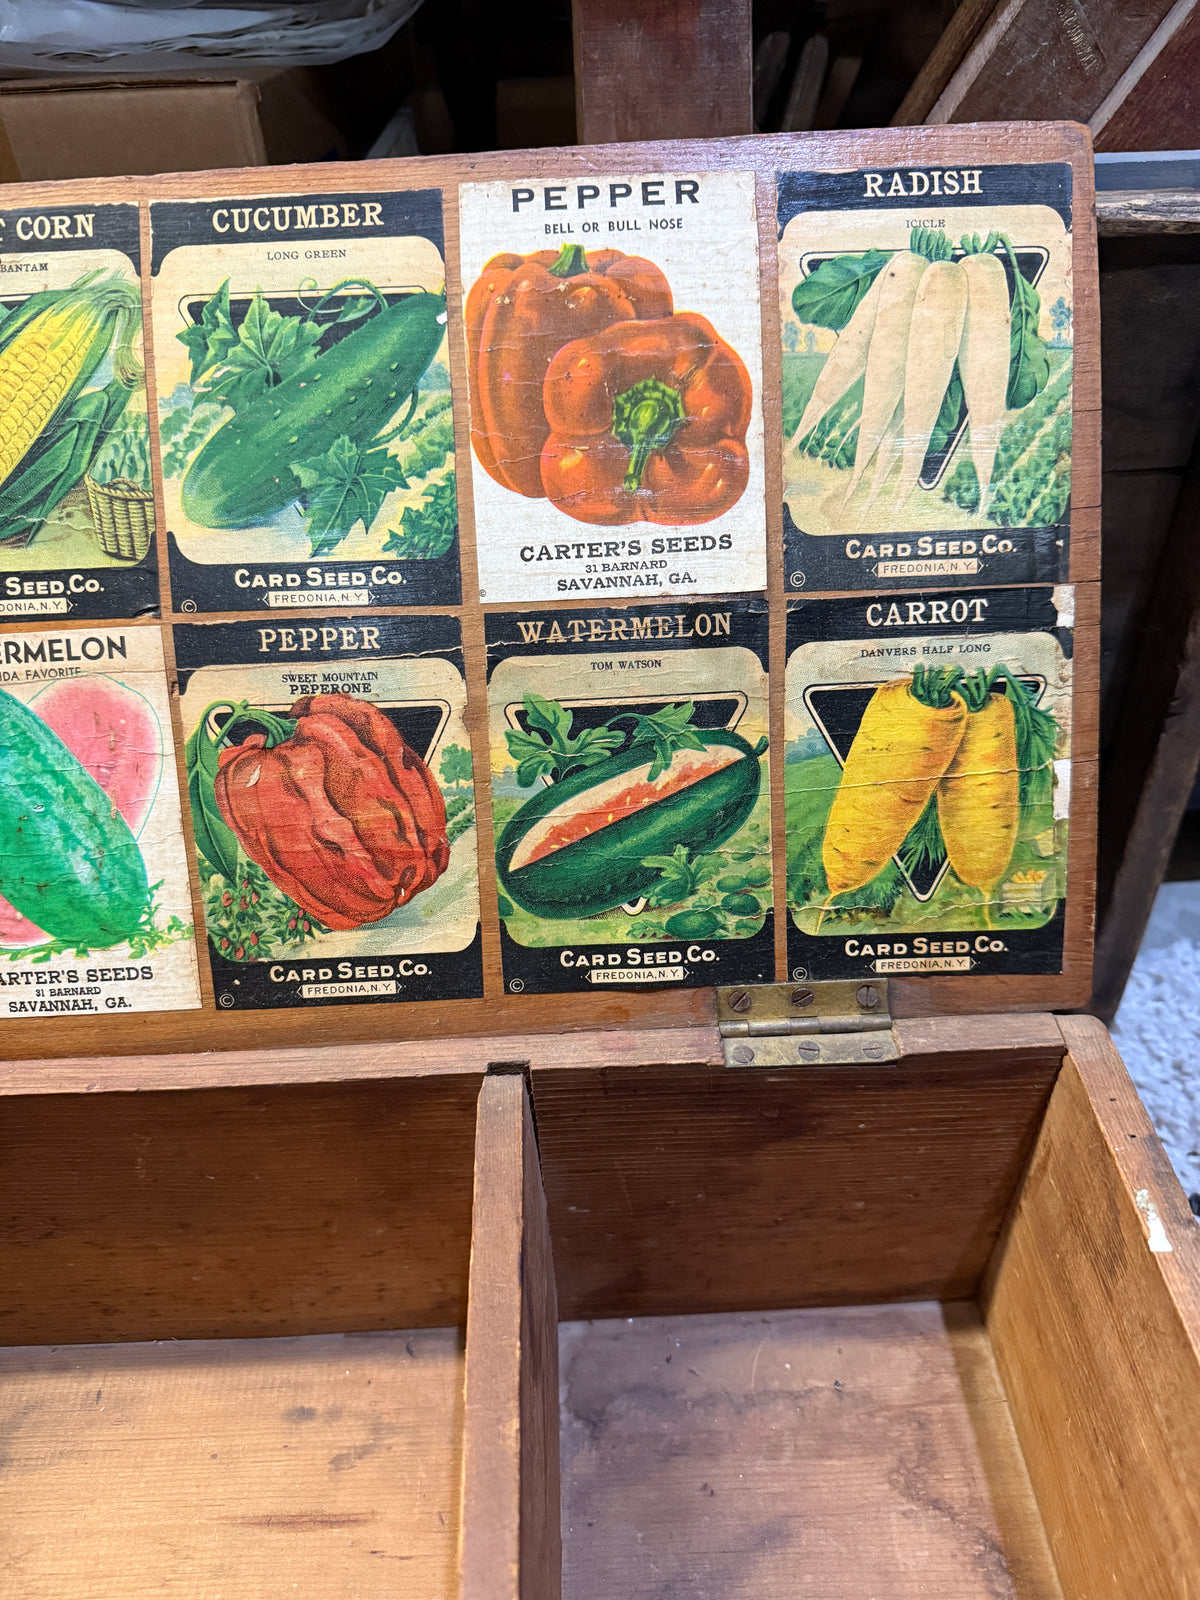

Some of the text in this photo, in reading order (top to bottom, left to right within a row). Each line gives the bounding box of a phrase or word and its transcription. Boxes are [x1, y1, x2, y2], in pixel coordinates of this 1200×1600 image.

[863, 170, 983, 198] RADISH
[511, 180, 700, 213] PEPPER
[212, 202, 385, 233] CUCUMBER
[544, 218, 683, 235] BELL OR BULL NOSE
[906, 219, 946, 229] ICICLE
[16, 213, 96, 241] CORN
[267, 249, 347, 261] LONG GREEN
[0, 263, 49, 273] BANTAM
[520, 534, 733, 562] CARTER'S SEEDS
[845, 539, 912, 560] CARD
[585, 559, 668, 573] 31 BARNARD
[234, 568, 301, 589] CARD
[557, 572, 698, 592] SAVANNAH, GA.
[866, 599, 989, 628] CARROT
[516, 612, 732, 644] WATERMELON
[258, 626, 381, 652] PEPPER
[0, 636, 127, 664] RMELON
[861, 643, 991, 658] DANVERS HALF LONG
[590, 659, 662, 671] TOM WATSON
[281, 671, 379, 684] SWEET MOUNTAIN
[289, 683, 372, 696] PEPERONE
[844, 940, 907, 957] CARD
[560, 950, 621, 968] CARD
[86, 966, 154, 983] SEEDS
[269, 965, 333, 983] CARD
[35, 986, 102, 998] 31 BARNARD
[9, 997, 132, 1013] SAVANNAH, GA.
